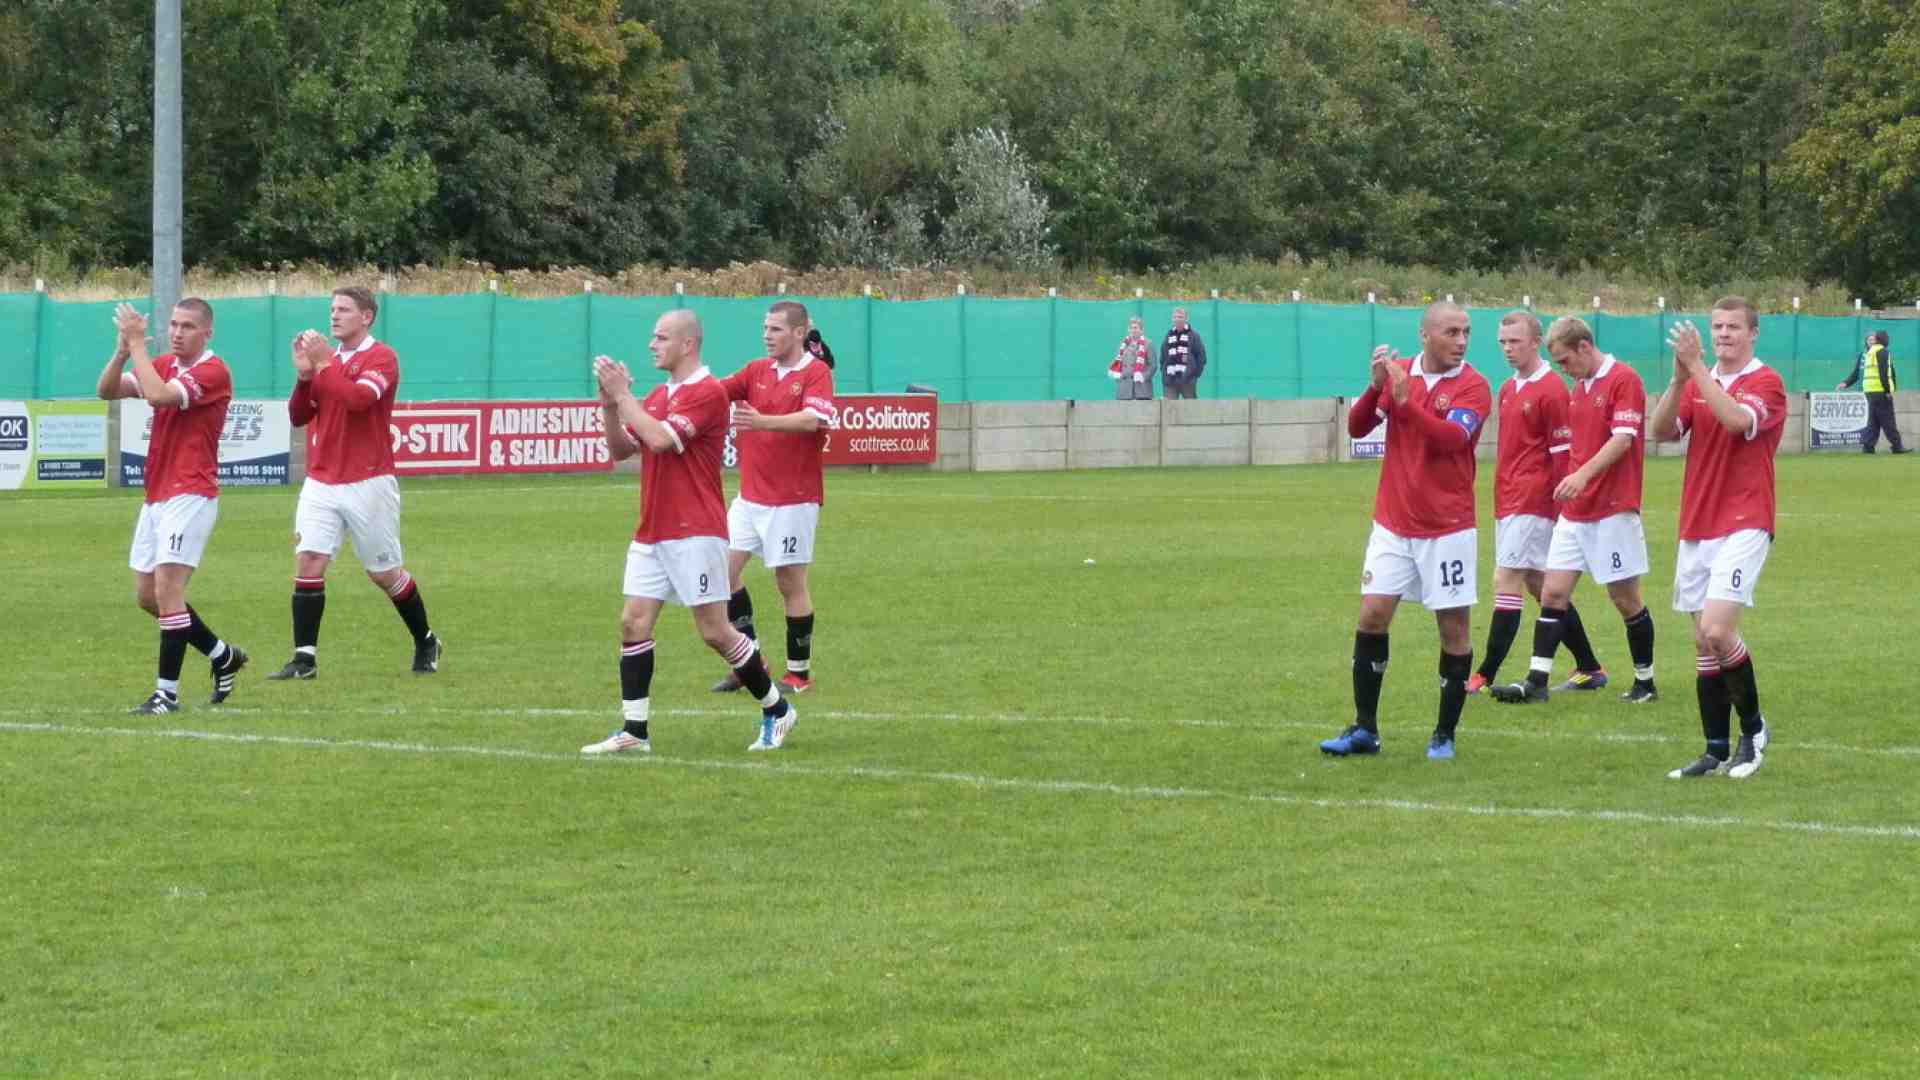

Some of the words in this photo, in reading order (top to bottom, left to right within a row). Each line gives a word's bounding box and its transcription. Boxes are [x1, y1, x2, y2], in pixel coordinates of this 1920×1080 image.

[489, 406, 606, 434] ADHESIVES
[843, 407, 864, 430] Co
[866, 405, 930, 430] Solicitors
[489, 441, 505, 466] &
[509, 436, 609, 465] SEALANTS
[849, 433, 930, 453] scottrees.co.uk
[169, 533, 184, 552] 11
[782, 536, 797, 553] 12
[1611, 551, 1622, 569] 8
[699, 573, 708, 593] 9
[1440, 560, 1464, 587] 12
[1732, 568, 1742, 588] 6
